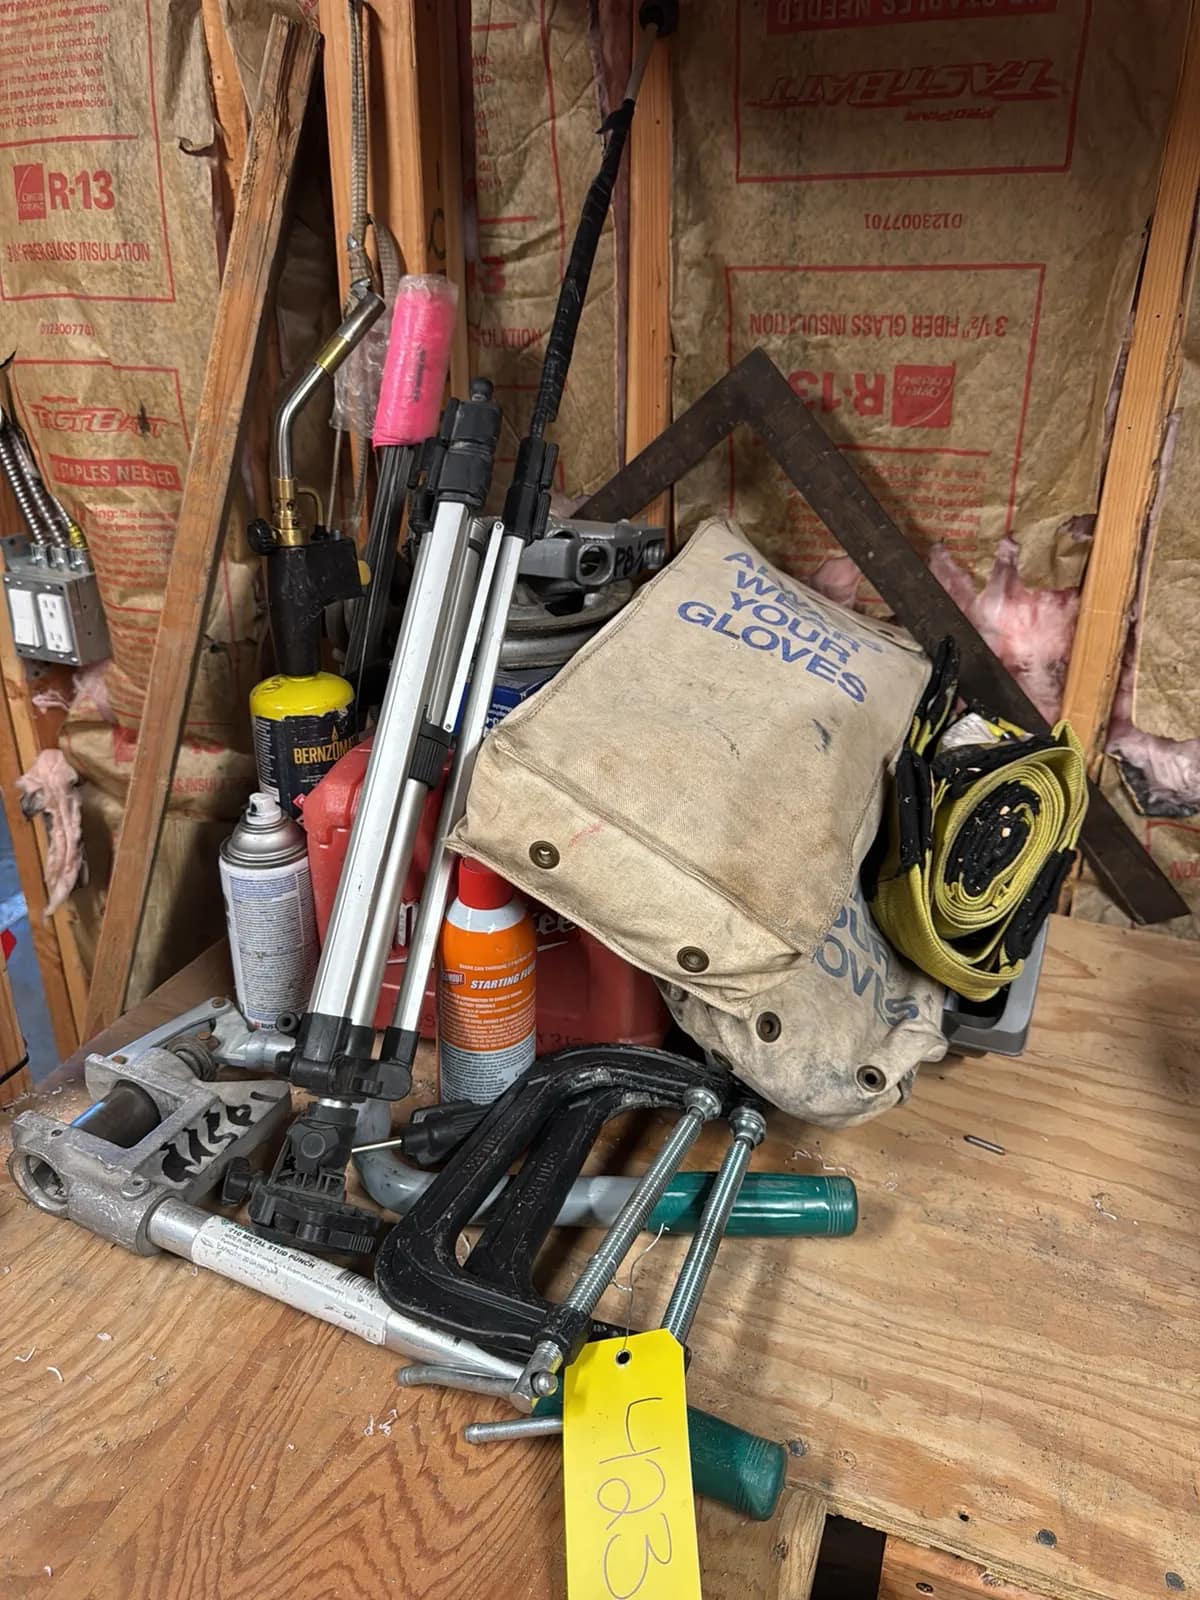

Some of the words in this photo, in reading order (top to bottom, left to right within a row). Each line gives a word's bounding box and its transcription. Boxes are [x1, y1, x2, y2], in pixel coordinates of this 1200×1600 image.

[863, 213, 963, 231] D123007701
[79, 242, 150, 261] INSULATION
[749, 312, 847, 338] INSULATION
[850, 313, 906, 337] GLASS
[911, 314, 959, 337] FIBER
[730, 591, 852, 665] YOUR
[677, 601, 868, 703] GLOVES
[470, 971, 520, 990] STARTING
[242, 1233, 267, 1249] METAL
[267, 1243, 289, 1257] STUD
[597, 1396, 673, 1600] 423
